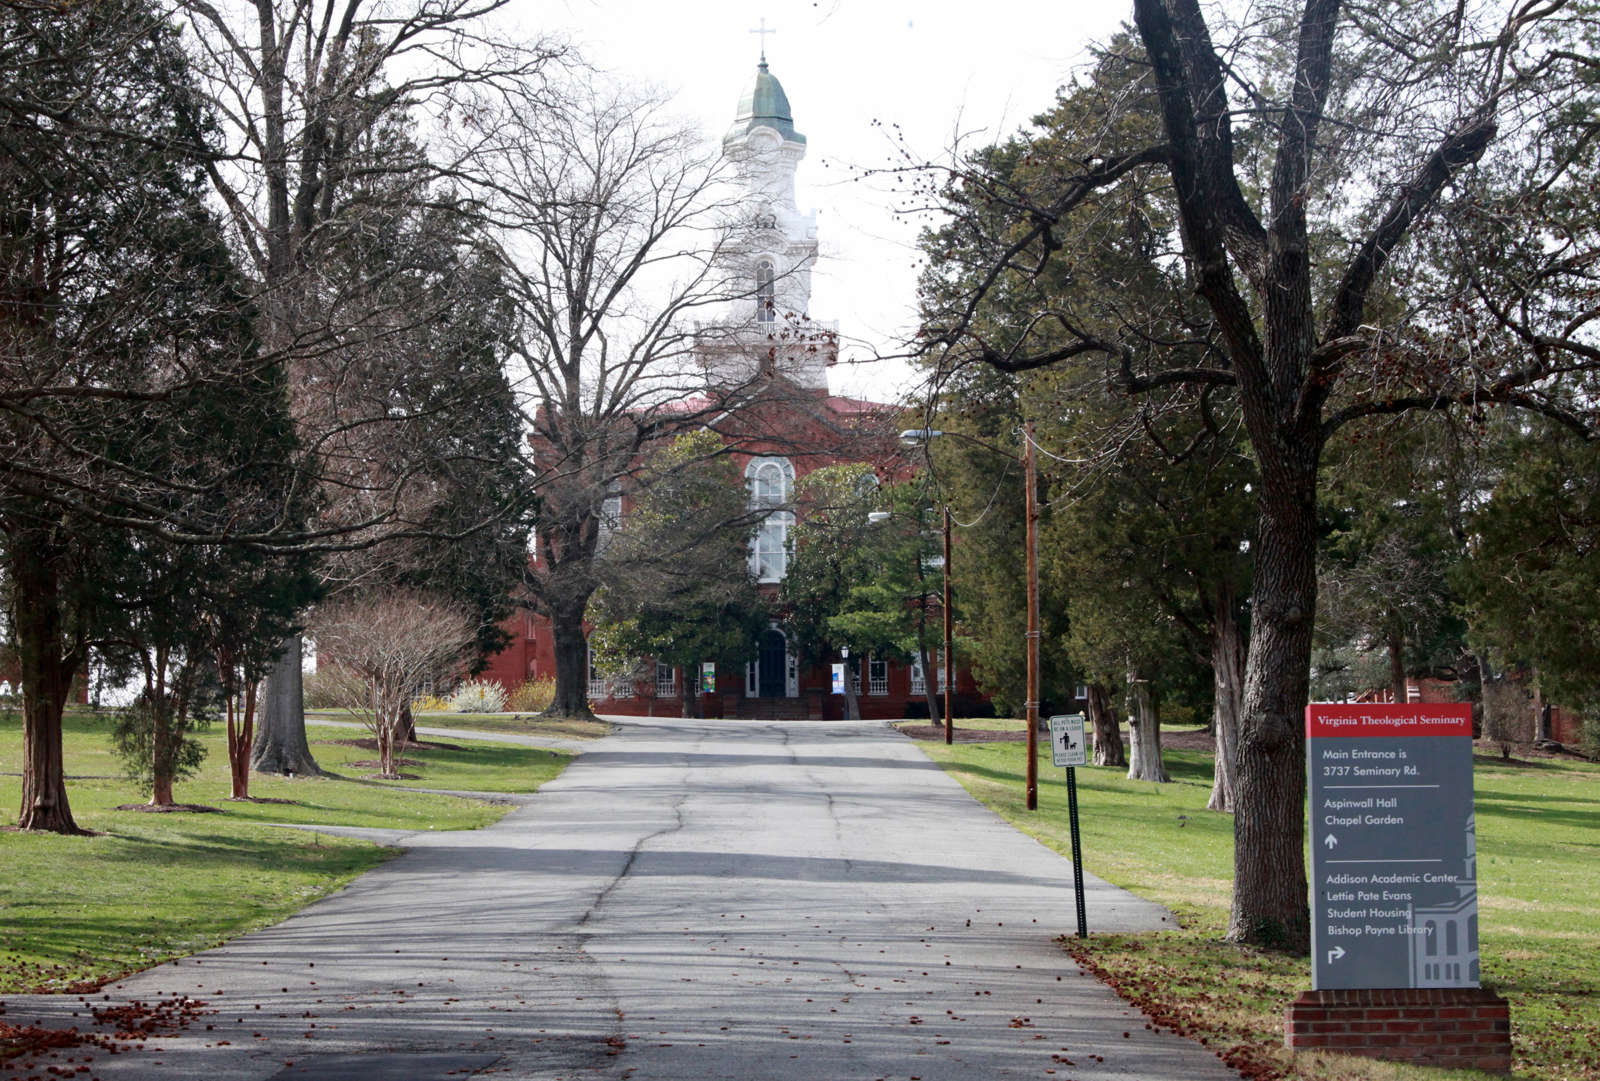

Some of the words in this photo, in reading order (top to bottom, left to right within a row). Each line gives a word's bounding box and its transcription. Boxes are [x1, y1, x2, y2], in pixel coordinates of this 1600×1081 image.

[1318, 716, 1358, 726] Virginia
[1360, 714, 1417, 726] Theological
[1420, 713, 1465, 726] Seminary
[1322, 750, 1349, 760] Main
[1352, 750, 1396, 759] Entrance
[1399, 749, 1407, 759] is
[1323, 766, 1350, 776] 3737
[1353, 766, 1401, 778] Seminary
[1404, 766, 1420, 776] Rd.
[1324, 798, 1373, 810] Aspinwall
[1376, 798, 1398, 808] Hall
[1325, 815, 1362, 827] Chapel
[1365, 815, 1404, 825] Garden
[1326, 874, 1368, 884] Addison
[1371, 874, 1421, 884] Academic
[1423, 873, 1459, 882] Center
[1327, 892, 1354, 902] Lettie
[1358, 891, 1380, 901] Pate
[1382, 890, 1412, 900] Evans
[1327, 908, 1367, 918] Student
[1369, 908, 1412, 920] Housing
[1328, 926, 1362, 936] Bishop
[1365, 926, 1396, 936] Payne
[1398, 924, 1434, 936] Library
